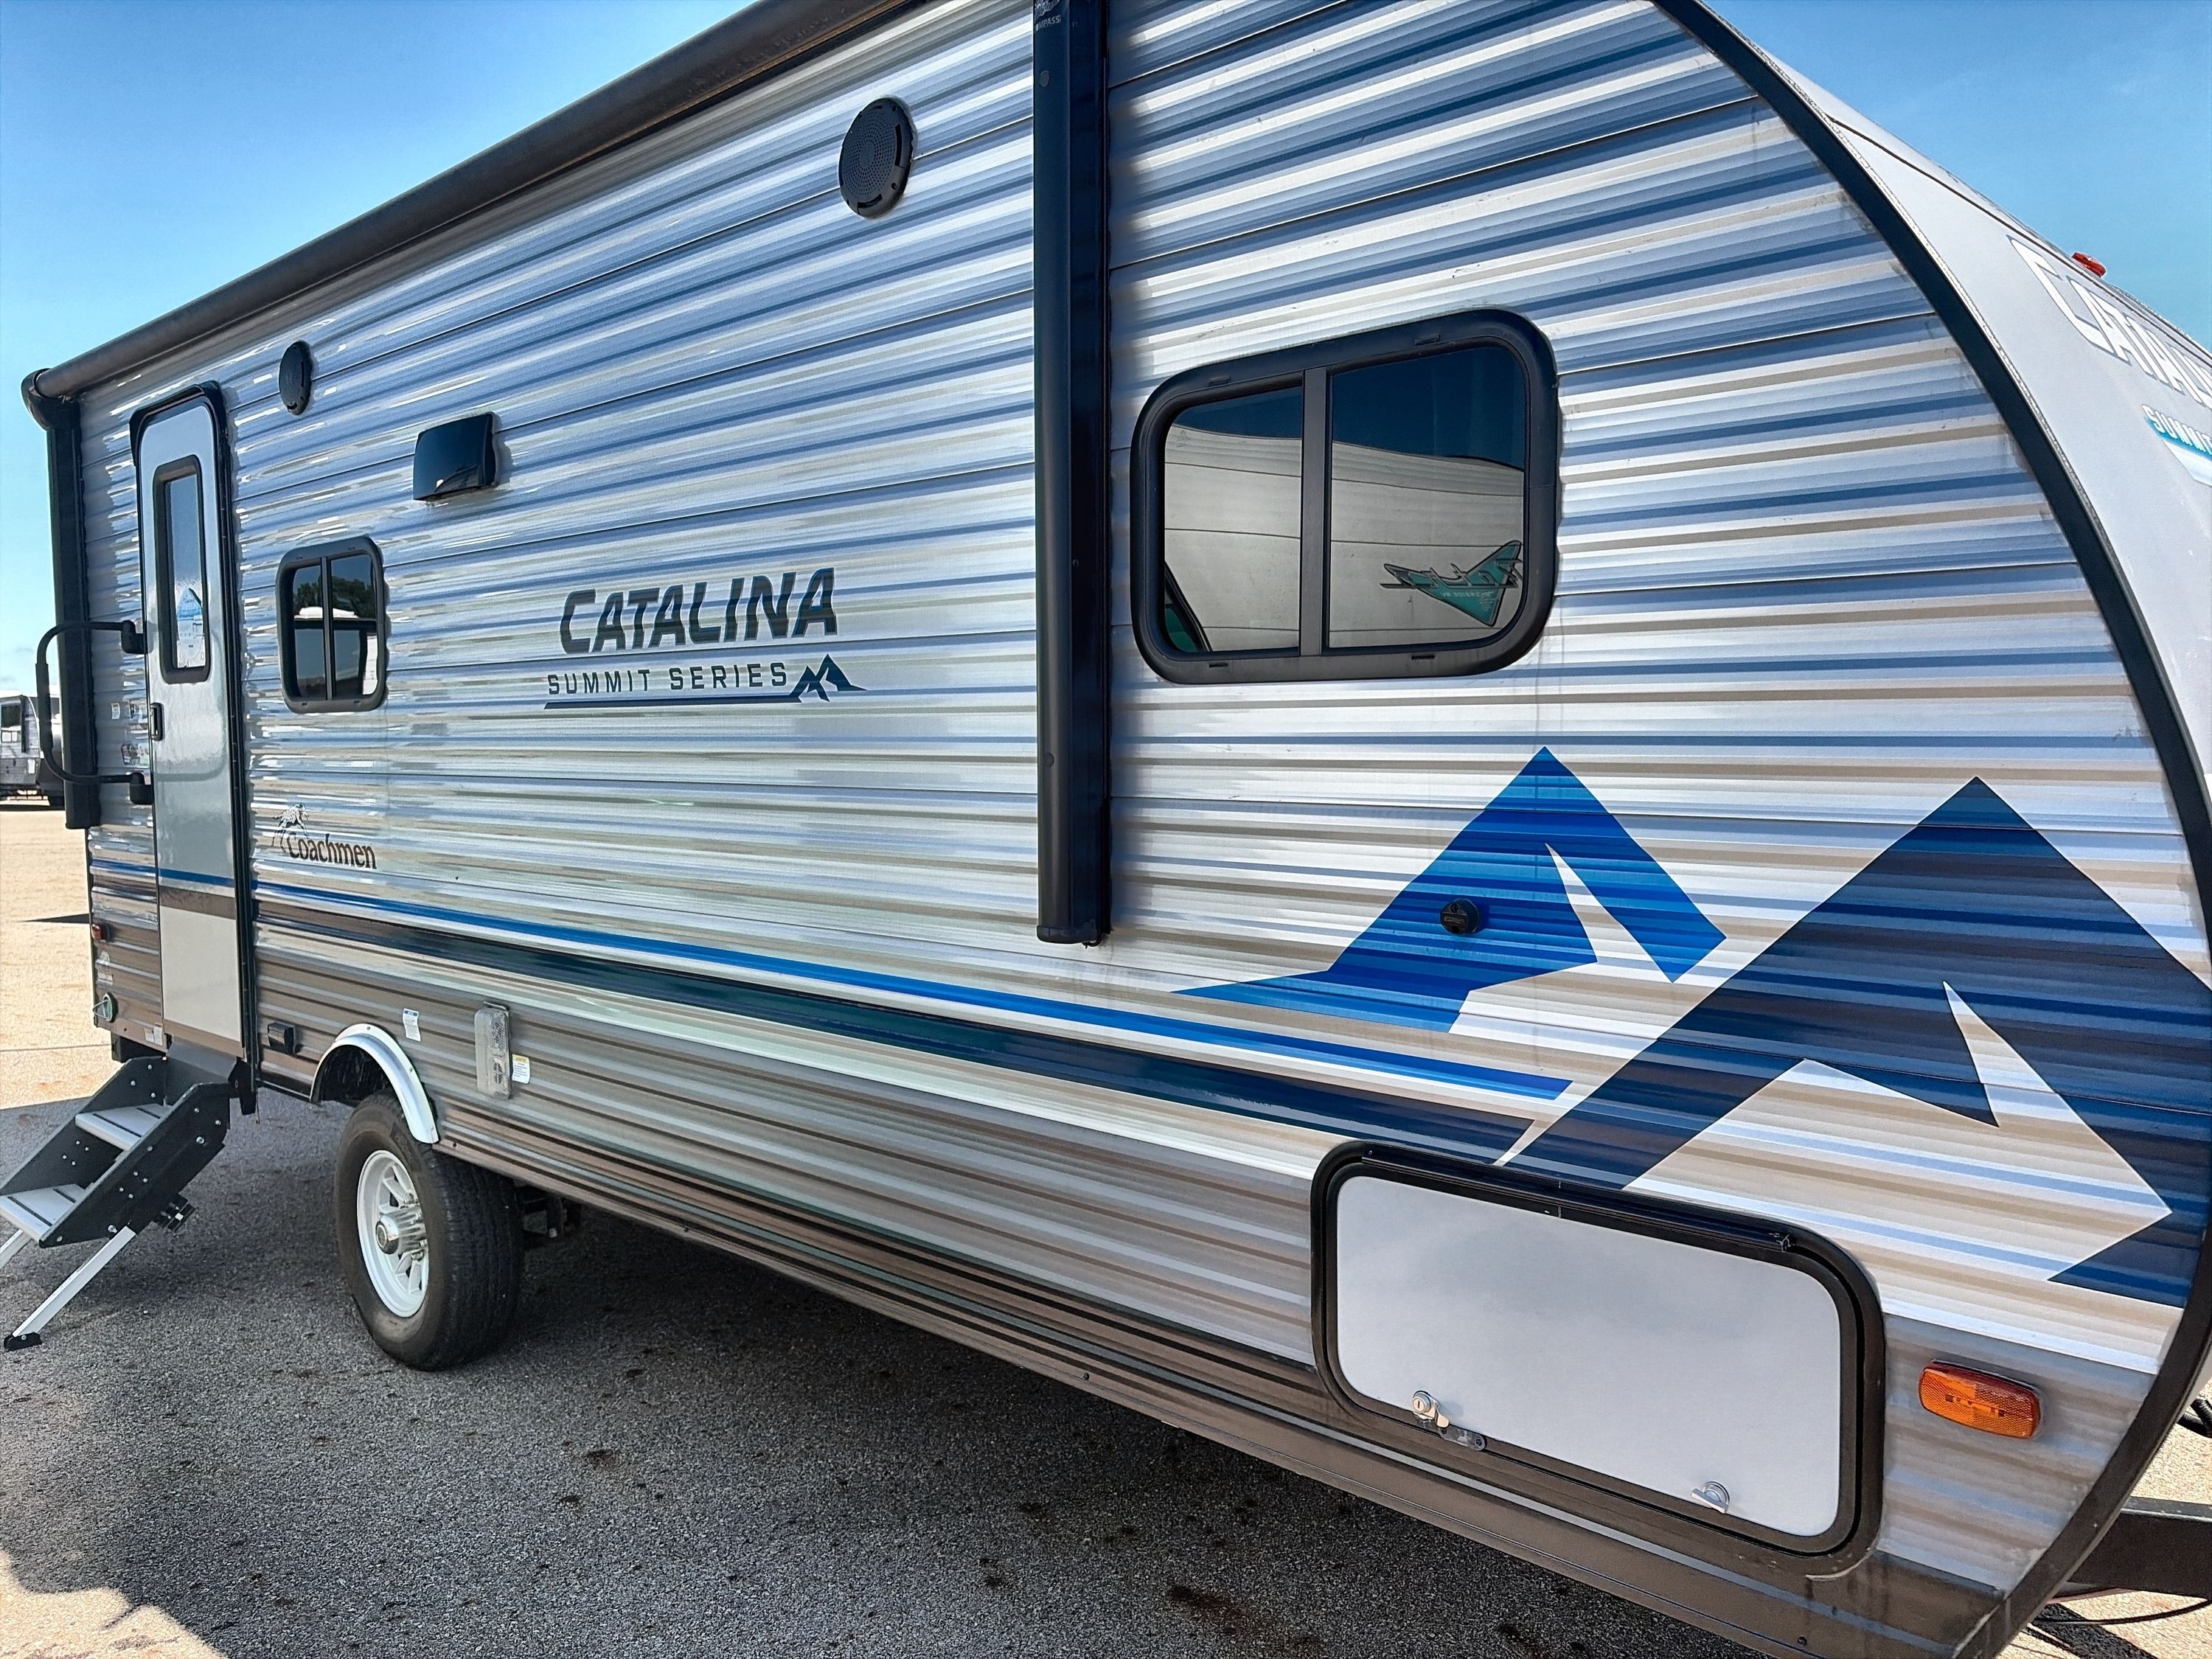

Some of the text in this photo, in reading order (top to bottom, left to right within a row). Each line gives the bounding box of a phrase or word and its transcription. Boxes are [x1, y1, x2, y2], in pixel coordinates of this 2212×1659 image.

[560, 567, 838, 655] CATALINA
[547, 662, 787, 695] SUMMIT SERIES
[287, 832, 378, 869] Coachmen
